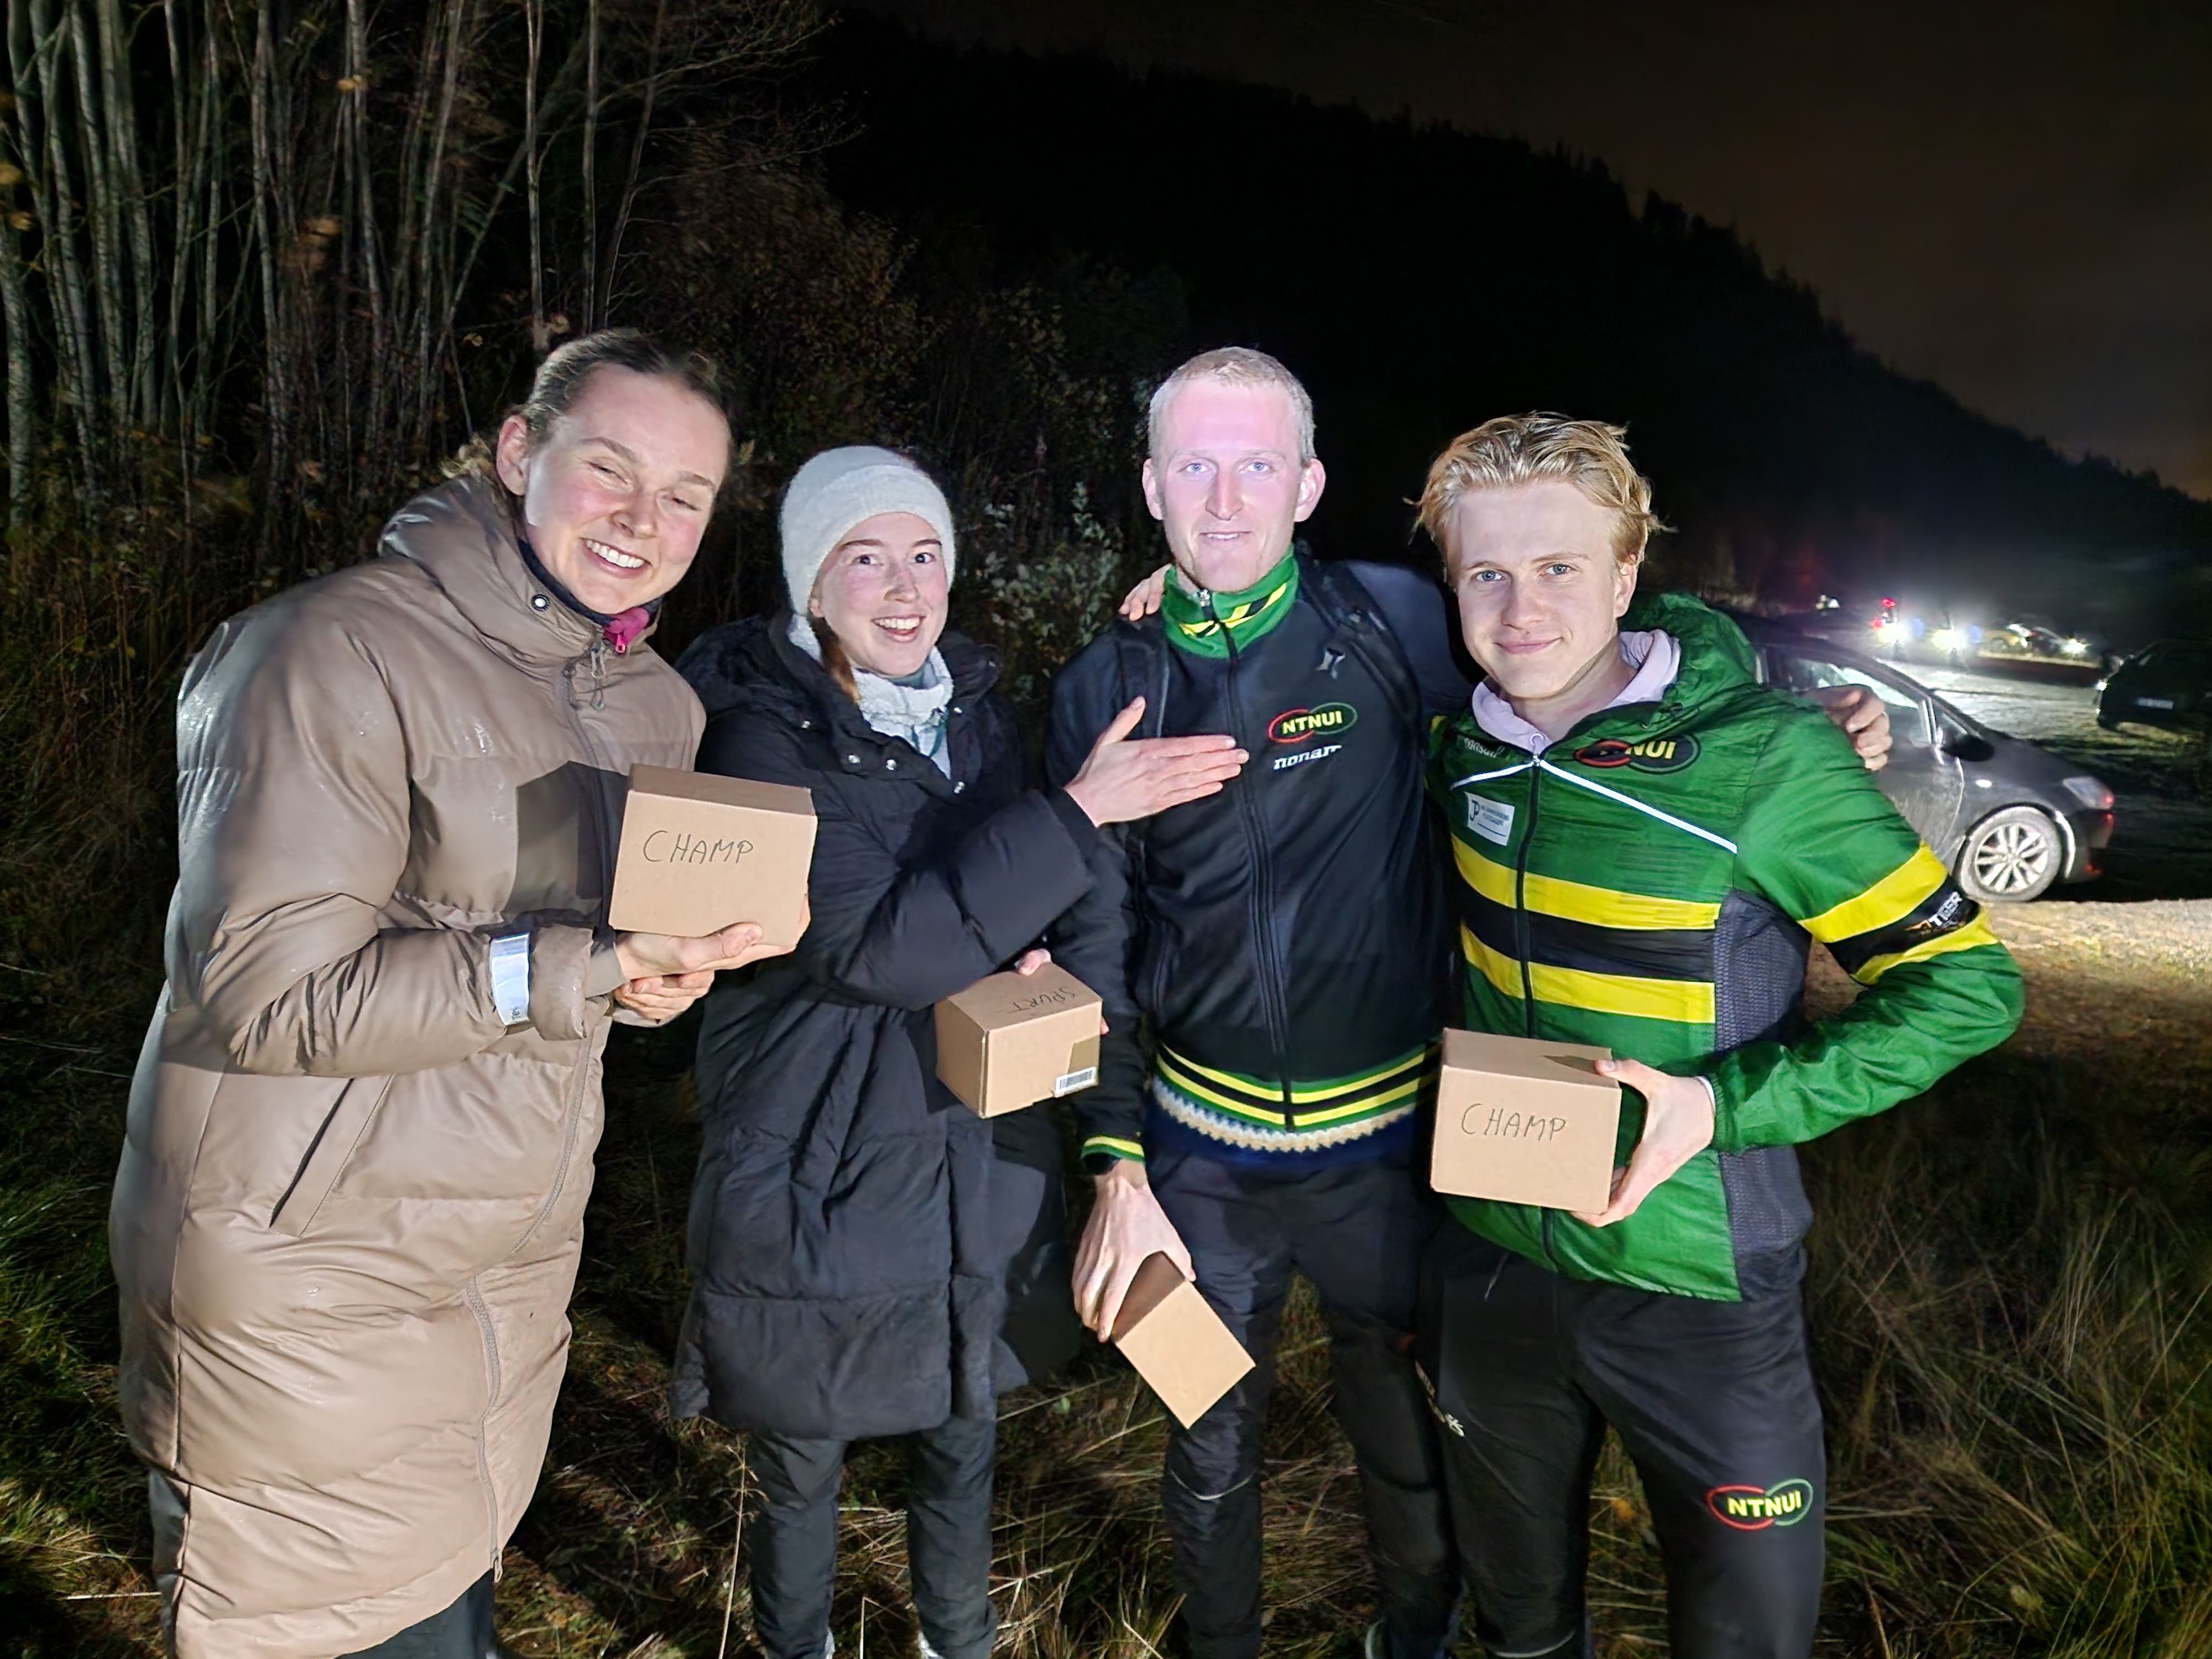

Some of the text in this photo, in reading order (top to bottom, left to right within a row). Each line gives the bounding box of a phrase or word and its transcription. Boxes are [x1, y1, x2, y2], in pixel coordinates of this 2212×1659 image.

[1282, 711, 1343, 734] NTNUI
[1599, 740, 1677, 760] NUI
[643, 830, 754, 864] CHAMP
[1006, 986, 1076, 1014] SPURT
[1461, 1103, 1566, 1141] CHAMP
[1727, 1490, 1802, 1517] NTNUI
